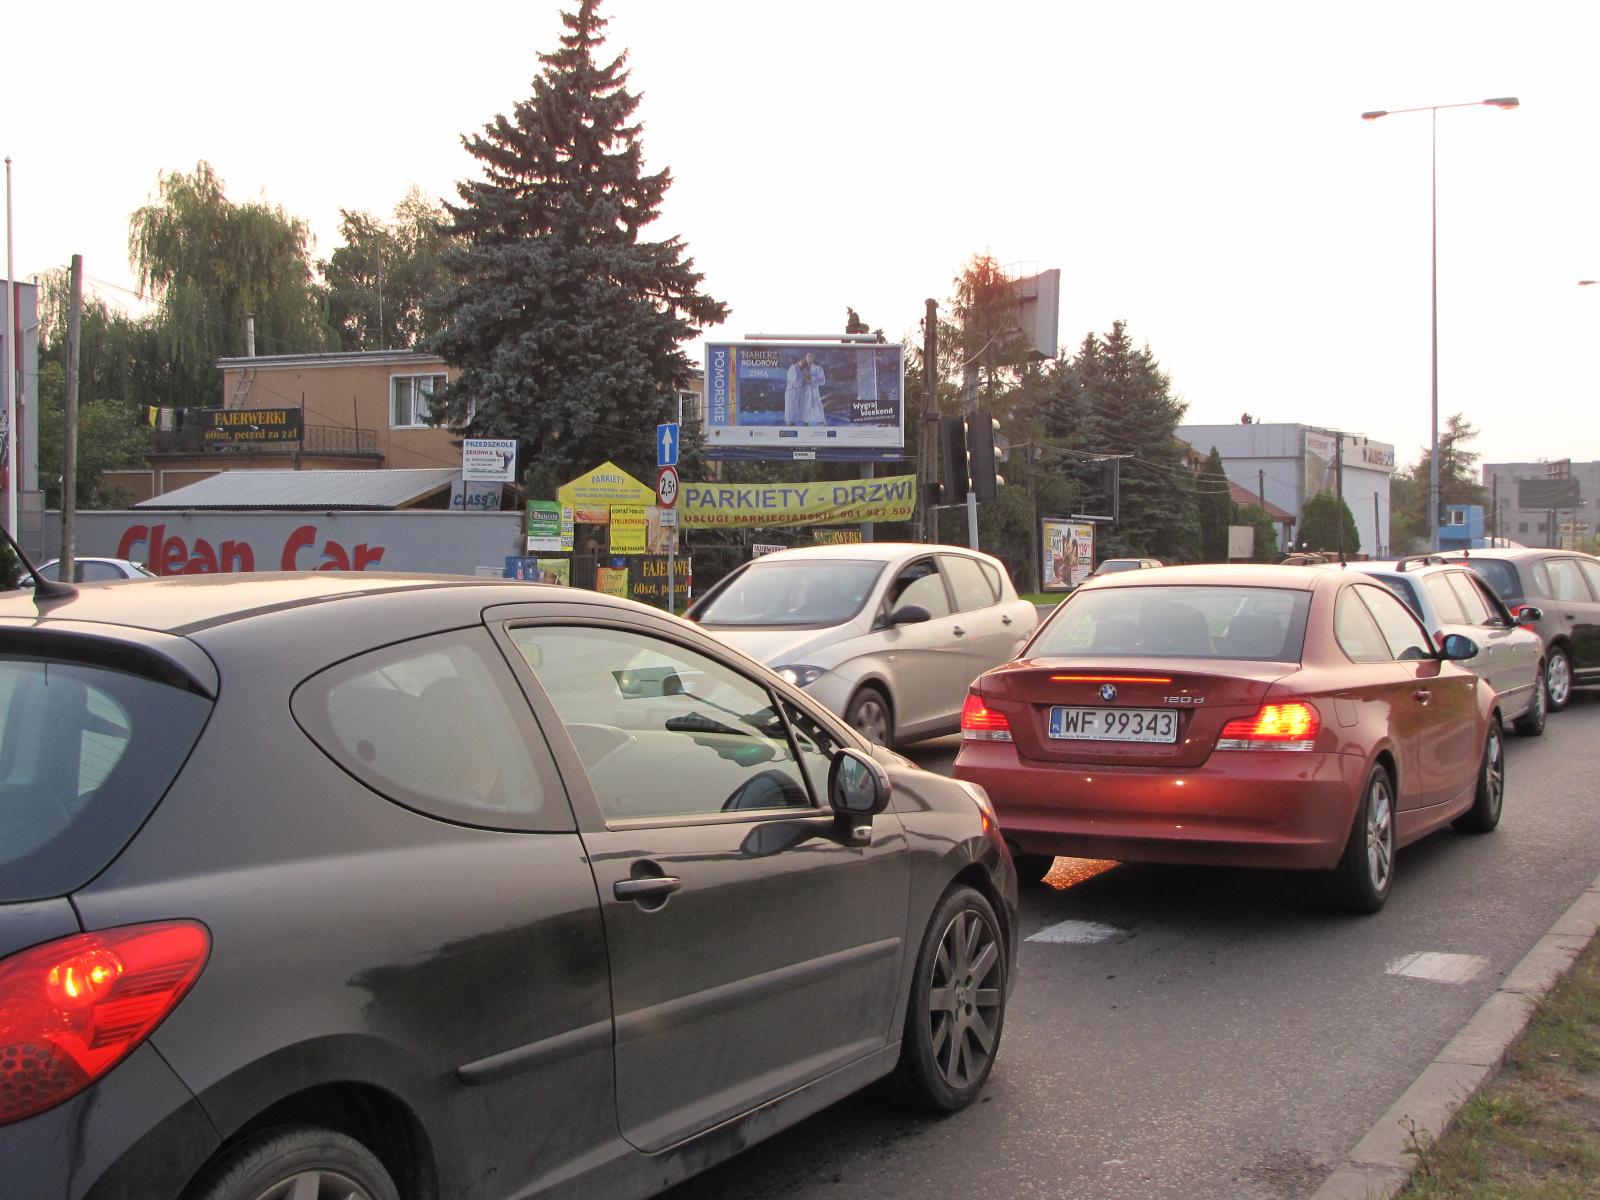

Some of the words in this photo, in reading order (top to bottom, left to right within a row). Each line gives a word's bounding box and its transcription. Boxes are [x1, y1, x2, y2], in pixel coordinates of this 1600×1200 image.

[741, 351, 778, 359] NABIERZ
[714, 351, 725, 422] POMORSKIE
[852, 401, 878, 410] Wygraj
[860, 407, 893, 416] Weekend
[214, 411, 287, 425] FAJERWERKI
[591, 474, 625, 485] PARKIETY
[660, 478, 676, 497] 2,5t
[685, 488, 809, 508] PARKIETY
[832, 481, 913, 506] DRZWI
[684, 514, 728, 523] USŁUGI
[840, 510, 860, 518] 601
[866, 508, 886, 516] 927
[116, 524, 254, 576] Clean
[281, 525, 386, 571] Car
[643, 561, 688, 577] FAJEWE
[1065, 711, 1097, 733] WF
[1104, 711, 1172, 736] 99343
